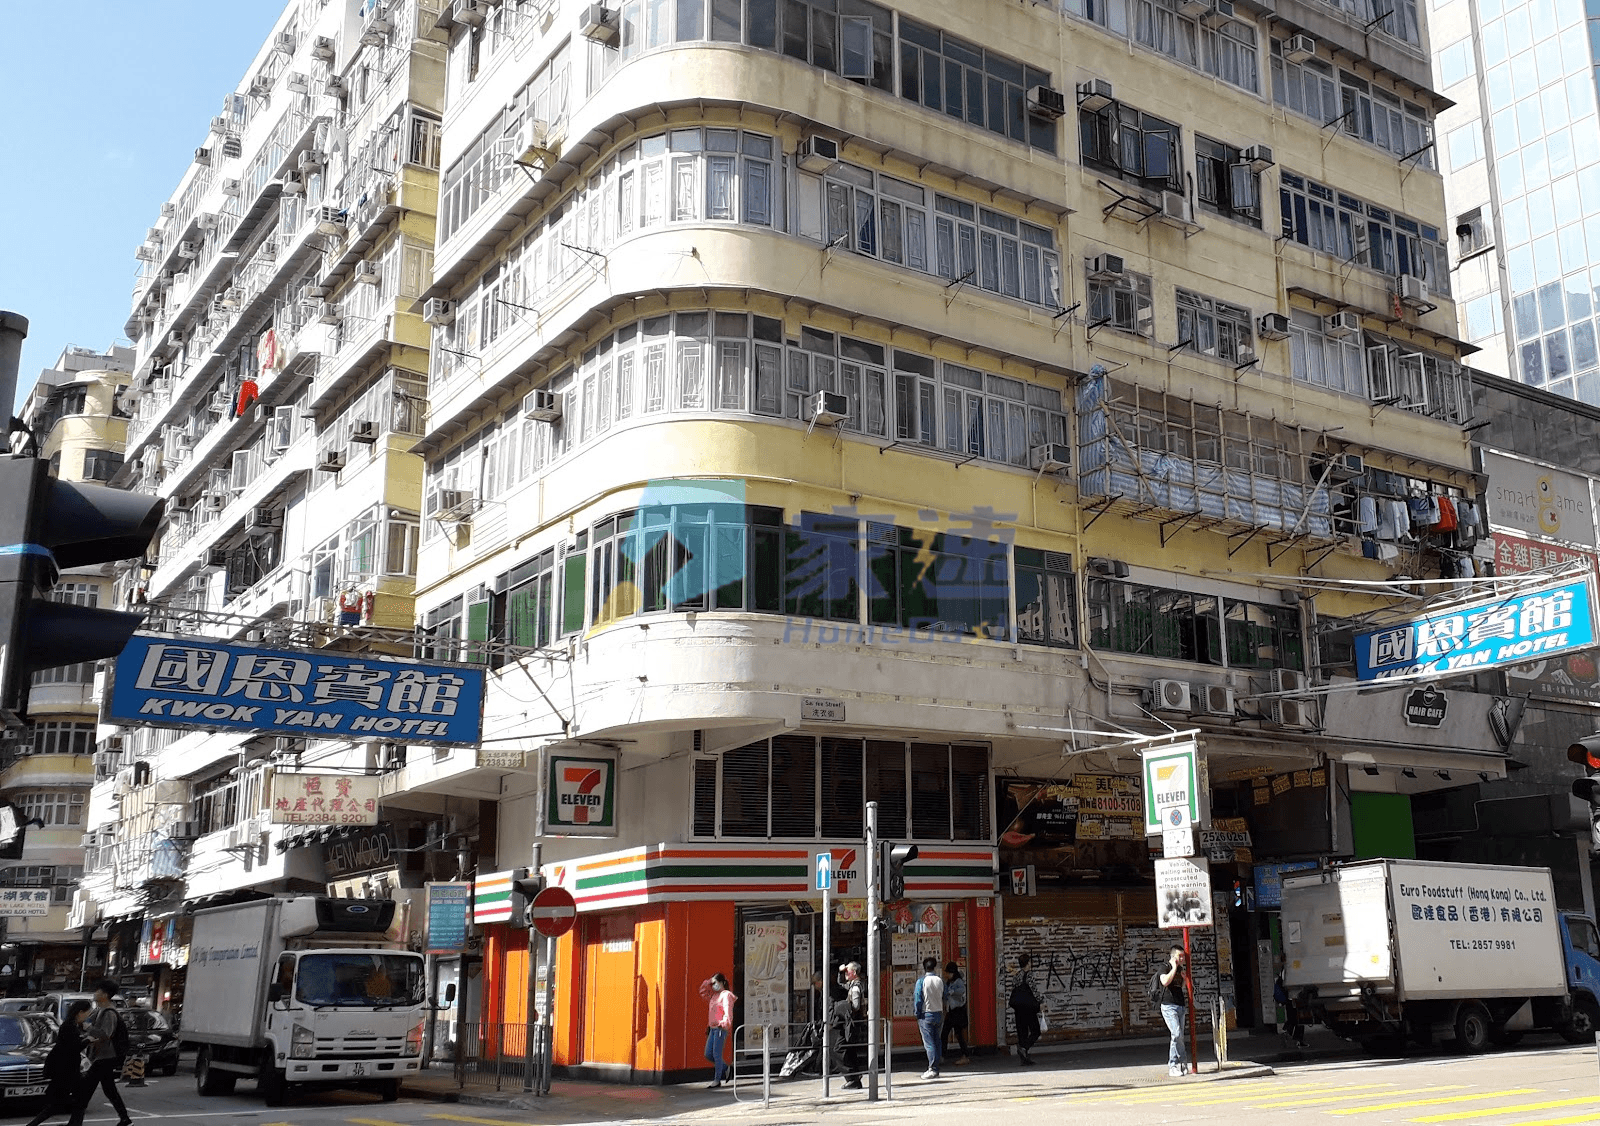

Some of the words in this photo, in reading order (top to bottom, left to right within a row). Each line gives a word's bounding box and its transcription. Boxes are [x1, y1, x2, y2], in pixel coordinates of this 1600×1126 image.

[1496, 487, 1536, 508] smart
[1368, 589, 1574, 668] 國恩賓館
[1447, 649, 1491, 669] YAN
[1496, 633, 1568, 660] HOTEL
[135, 643, 465, 717] 國恩賓館
[139, 698, 262, 722] KWOK
[274, 708, 344, 729] YAN
[350, 716, 449, 737] HOTEL
[1408, 705, 1426, 718] HAIR
[1427, 707, 1443, 718] CAFE
[563, 767, 601, 823] 7
[341, 813, 368, 823] 9201
[328, 833, 390, 871] KENWOOD
[1160, 868, 1180, 876] waiting
[1165, 874, 1198, 882] prosecuted
[0, 890, 48, 902] 湖賓館
[1400, 883, 1420, 897] Euro
[1422, 885, 1463, 899] Foodstuff
[1467, 886, 1490, 901] (Hong
[1491, 888, 1511, 902] Kong)
[1514, 889, 1529, 901] Co.,
[1531, 889, 1547, 902] Ltd.
[1450, 939, 1470, 950] TEL:
[1472, 939, 1493, 950] 2857
[1495, 939, 1516, 950] 9981
